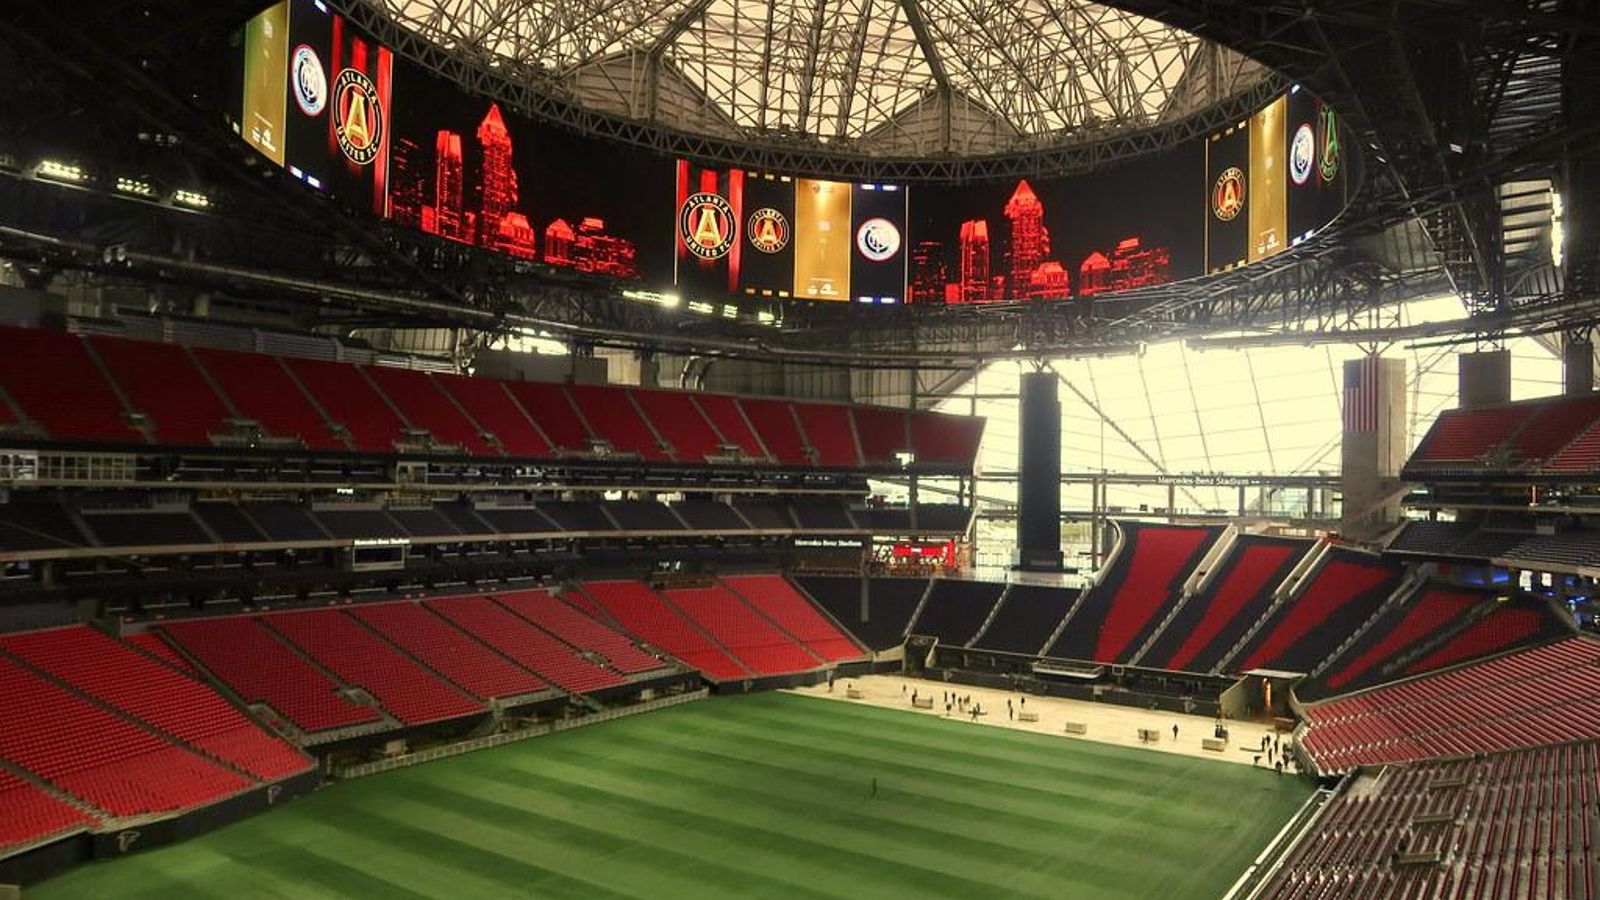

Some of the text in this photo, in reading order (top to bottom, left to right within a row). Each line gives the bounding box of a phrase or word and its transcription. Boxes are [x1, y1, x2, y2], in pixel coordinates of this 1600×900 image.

[341, 72, 377, 104] ATLANTA
[337, 126, 365, 161] UNITED
[688, 196, 729, 213] ATLANTA
[686, 235, 731, 257] UNITED FC
[1216, 477, 1249, 487] Stadium
